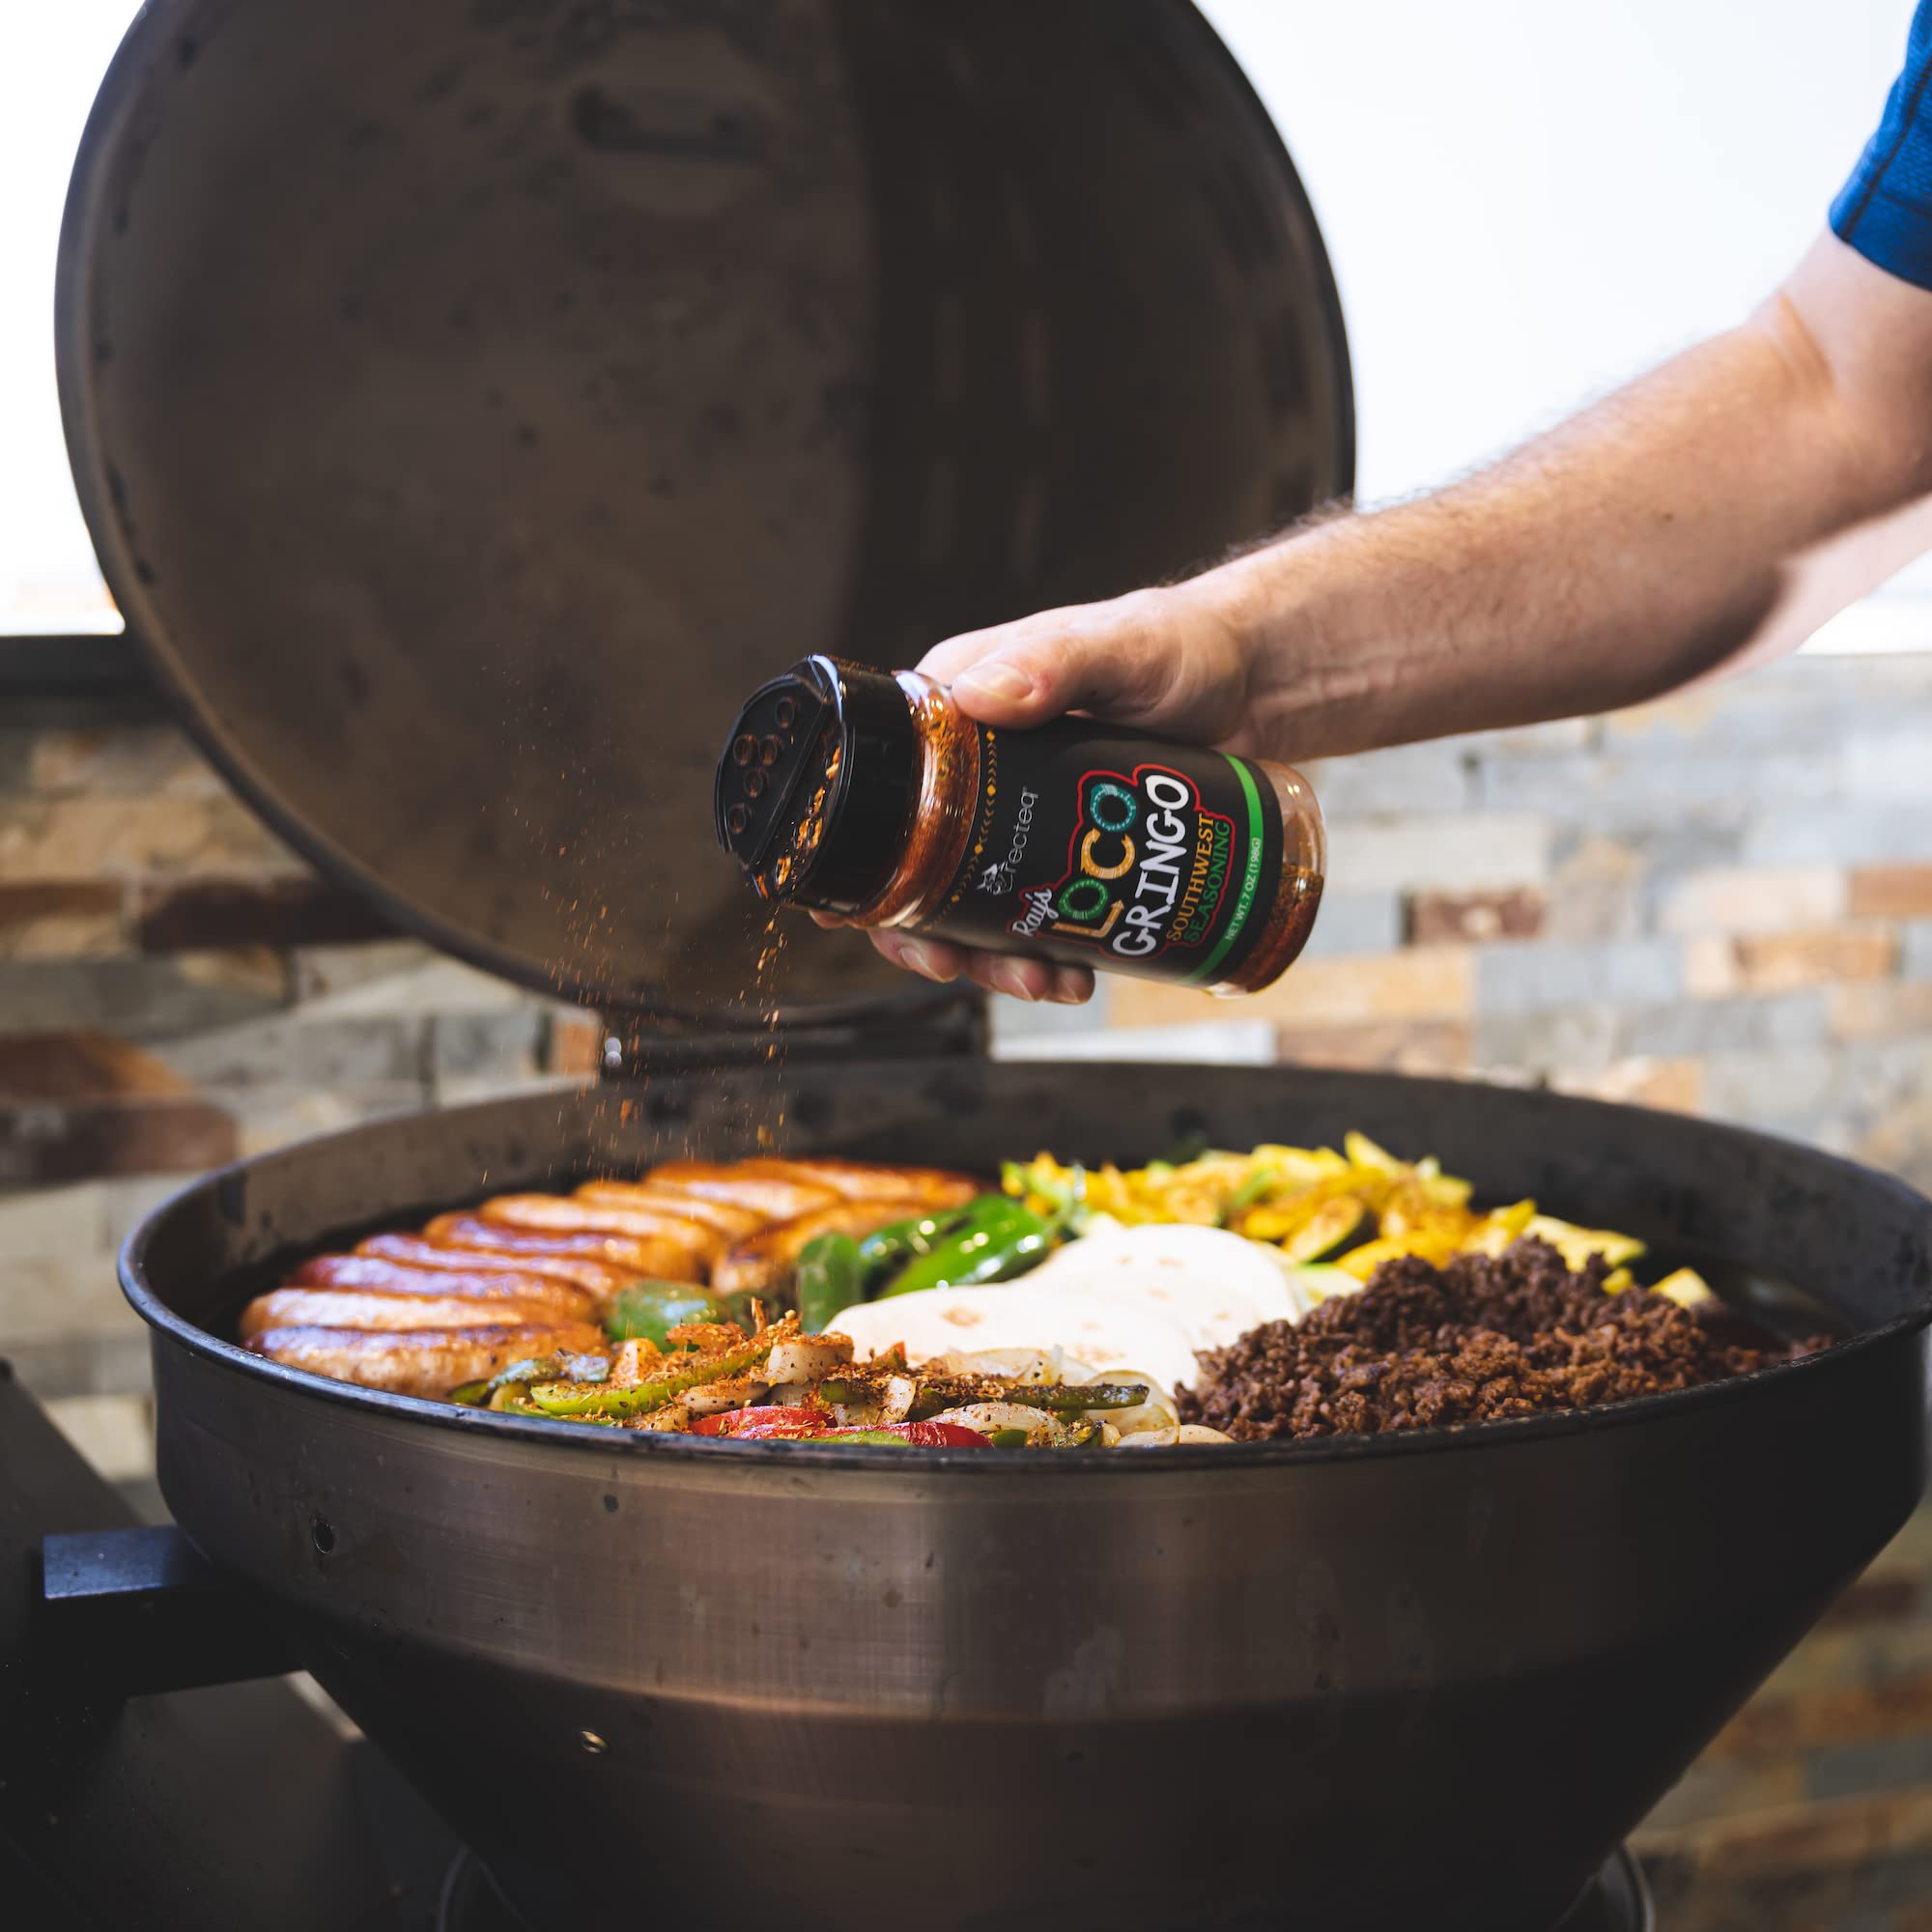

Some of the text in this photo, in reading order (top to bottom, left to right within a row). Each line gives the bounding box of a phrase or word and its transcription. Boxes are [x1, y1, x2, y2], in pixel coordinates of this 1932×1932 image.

[1005, 789, 1039, 874] recteq
[1051, 782, 1137, 939] LOCO
[1113, 774, 1190, 956] GRINGO
[1166, 812, 1214, 942] SOUTHWEST
[1183, 820, 1231, 943] SEASONING
[1225, 837, 1263, 941] NET WT. 7 OZ (198G)
[1012, 888, 1060, 938] Ray's
